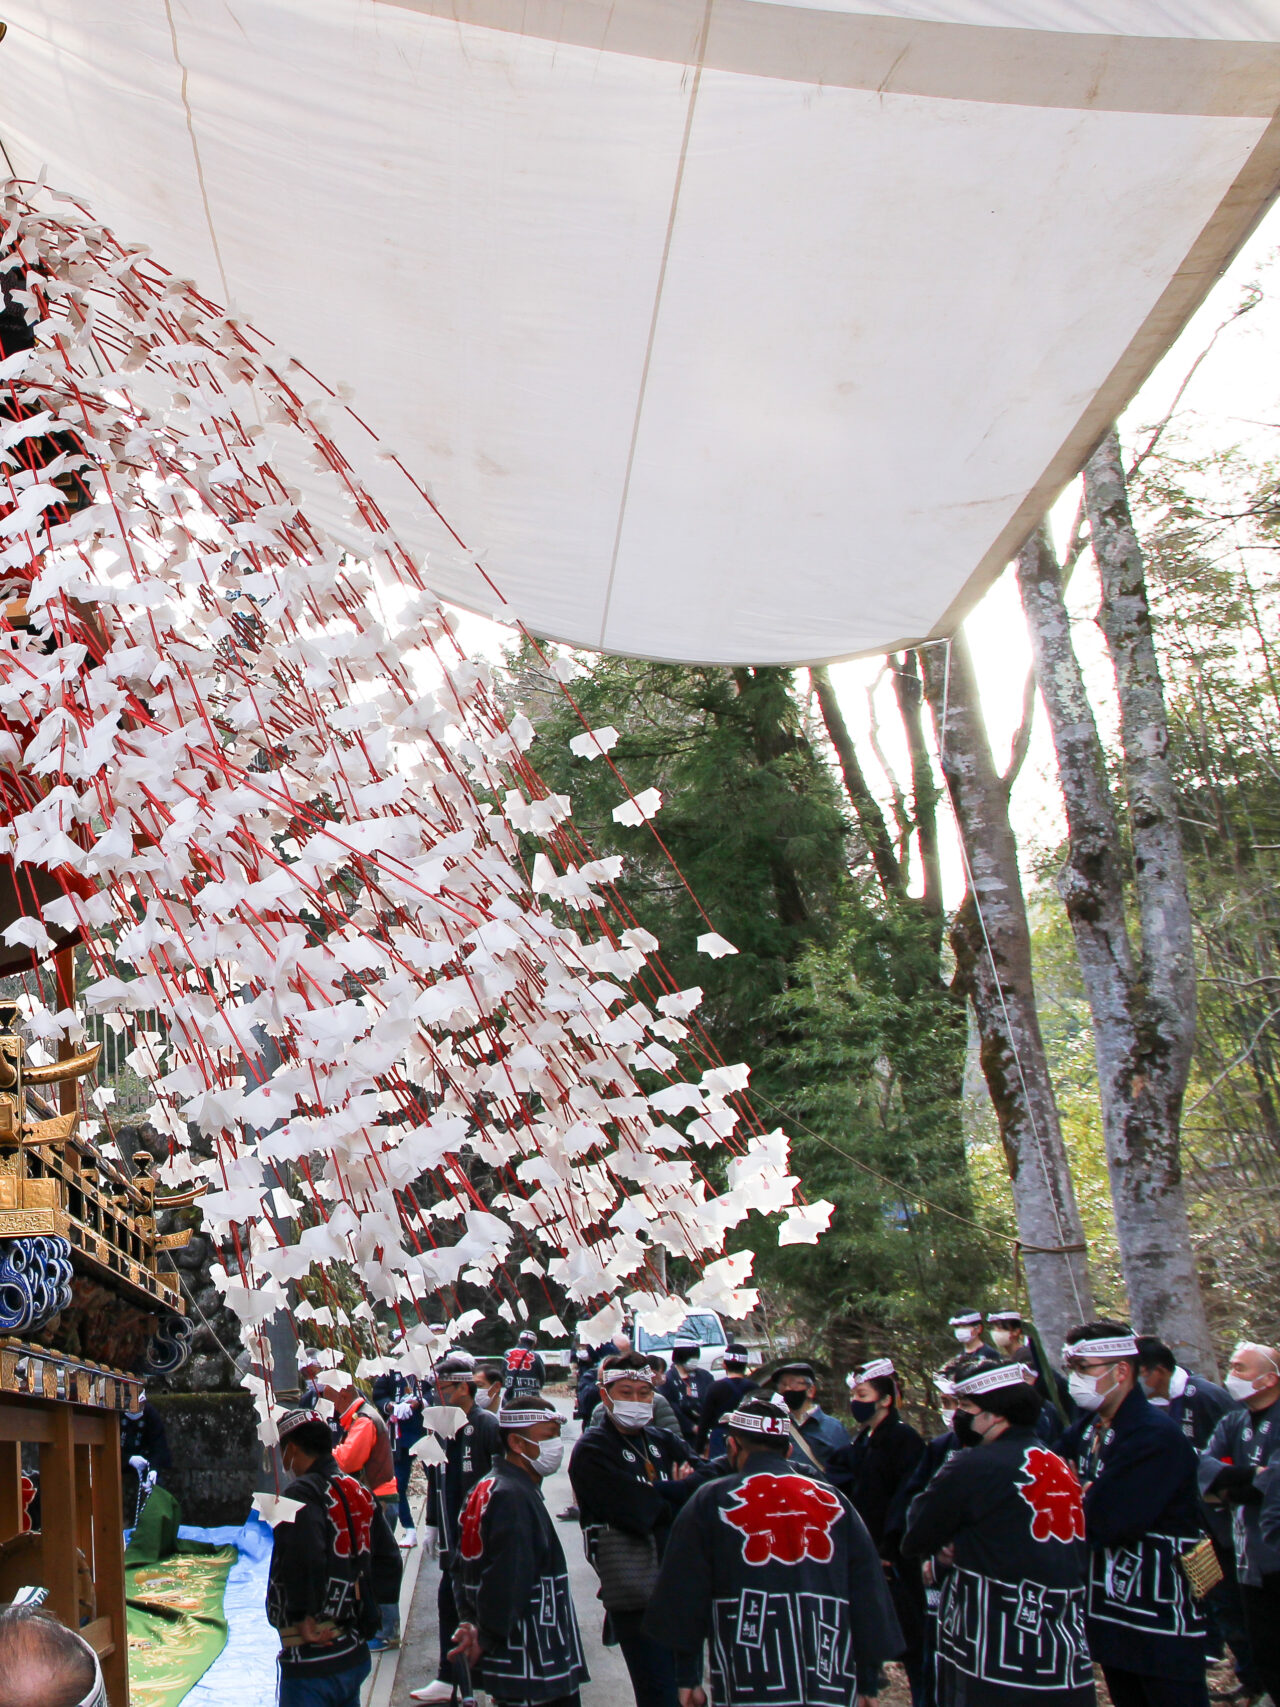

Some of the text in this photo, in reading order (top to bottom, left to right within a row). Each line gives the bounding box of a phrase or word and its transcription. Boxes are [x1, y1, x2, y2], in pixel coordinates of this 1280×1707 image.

[766, 1417, 781, 1433] 上
[1181, 1407, 1195, 1438] 上組
[462, 1445, 473, 1473] 上組
[1248, 1445, 1262, 1462] 上
[1013, 1446, 1086, 1543] 祭
[718, 1473, 846, 1566] 祭
[742, 1600, 758, 1638] 上組
[1020, 1589, 1037, 1624] 上組
